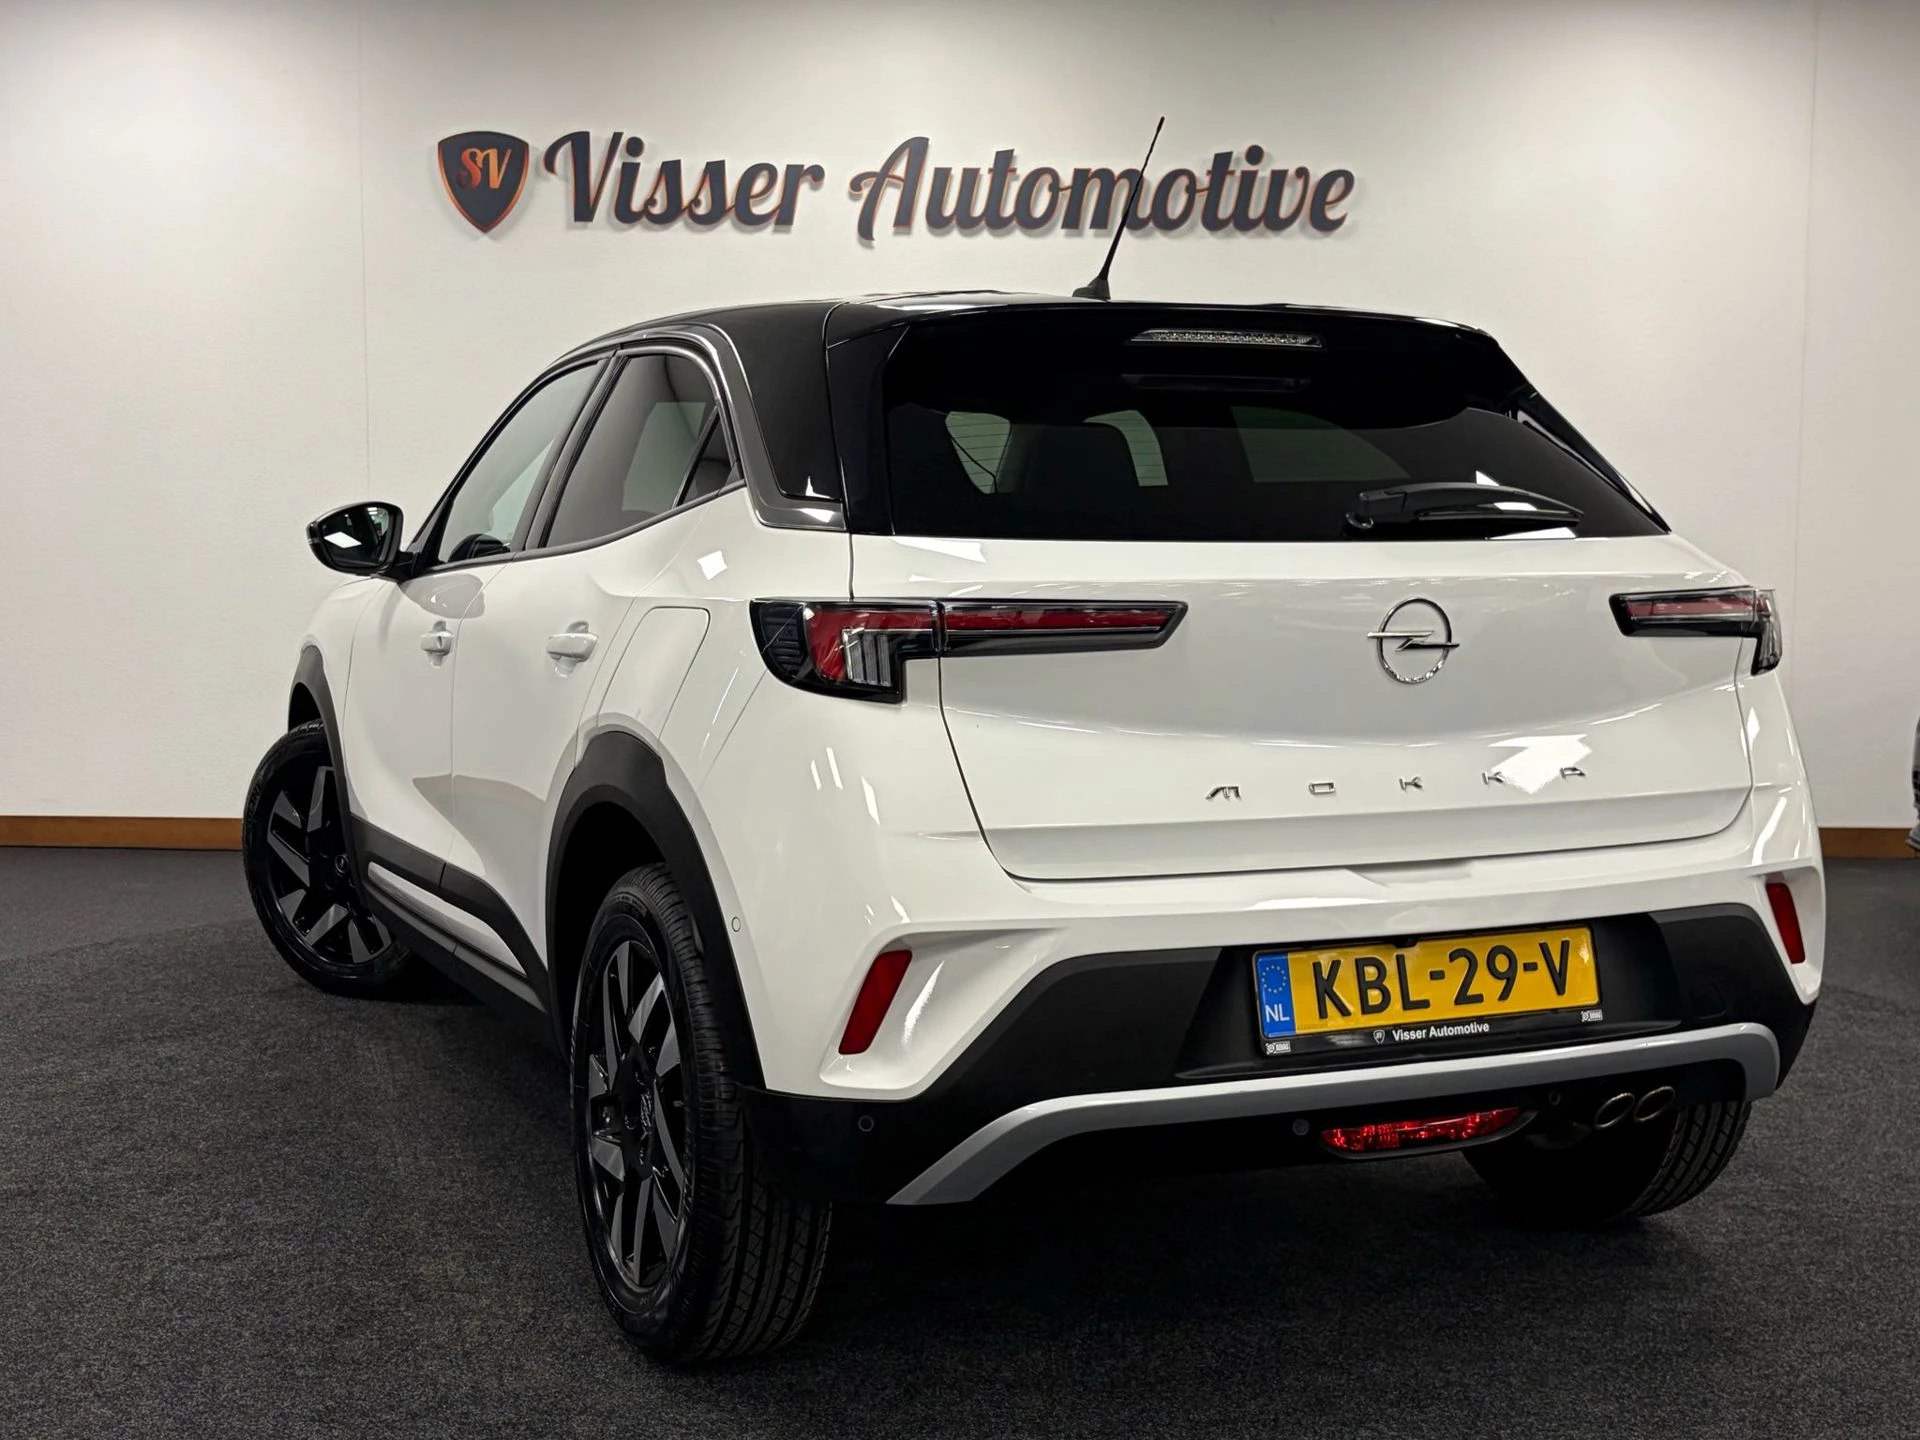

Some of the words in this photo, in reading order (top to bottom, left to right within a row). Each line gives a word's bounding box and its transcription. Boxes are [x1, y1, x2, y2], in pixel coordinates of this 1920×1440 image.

[456, 147, 512, 190] SV
[543, 131, 826, 226] Visser
[849, 136, 1356, 241] Automotive
[1206, 767, 1586, 801] MOKKA
[1312, 939, 1571, 1020] KBL-29-V
[1265, 1004, 1290, 1022] NL
[1392, 1028, 1427, 1041] Visser
[1429, 1021, 1490, 1038] Automotive
